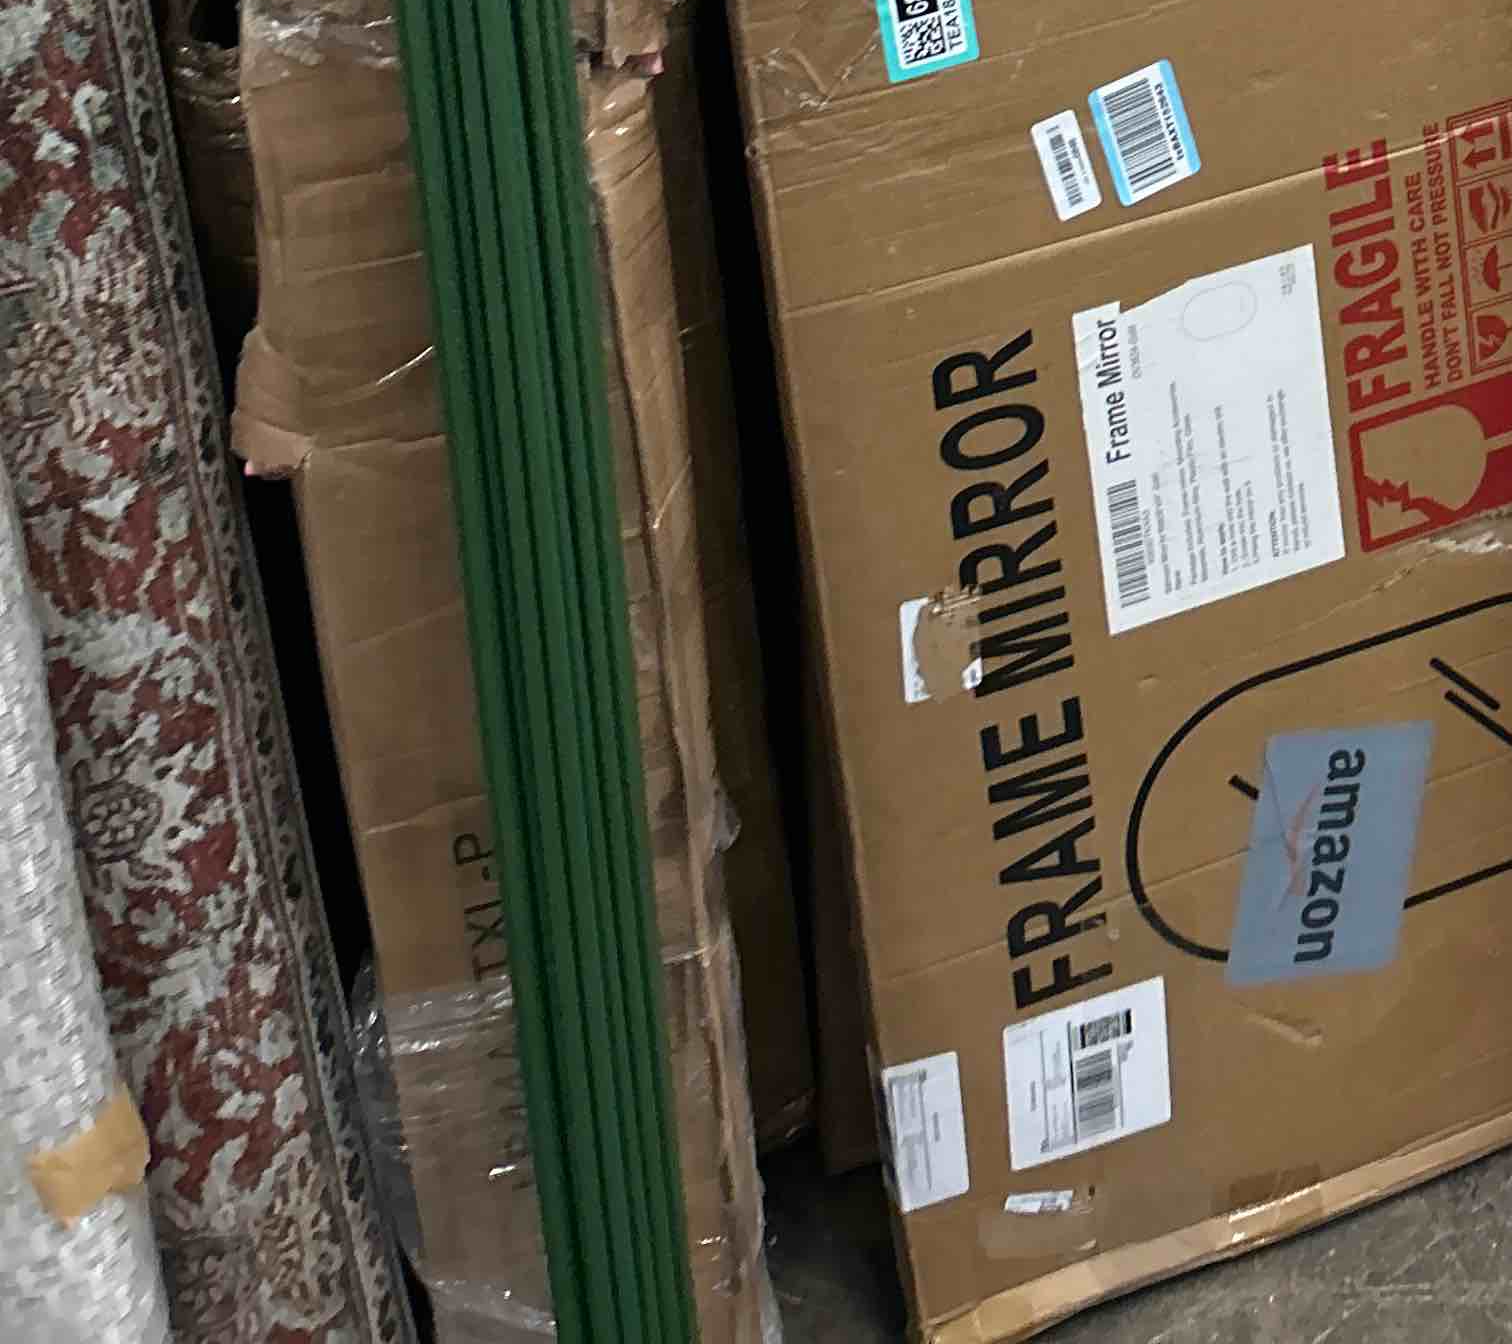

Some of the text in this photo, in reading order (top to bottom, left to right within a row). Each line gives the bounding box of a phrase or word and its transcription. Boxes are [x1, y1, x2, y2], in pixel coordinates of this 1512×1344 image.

[1096, 318, 1120, 389] Mirror
[1322, 137, 1411, 414] FRAGILE
[1405, 172, 1441, 389] HANDLE WITH CARE
[1423, 121, 1464, 383] DON'T FALL NOT PRESSURE
[932, 328, 1074, 699] MIRROR
[1106, 391, 1131, 463] Frame
[979, 696, 1112, 1009] FRAME
[1293, 748, 1366, 964] amazon
